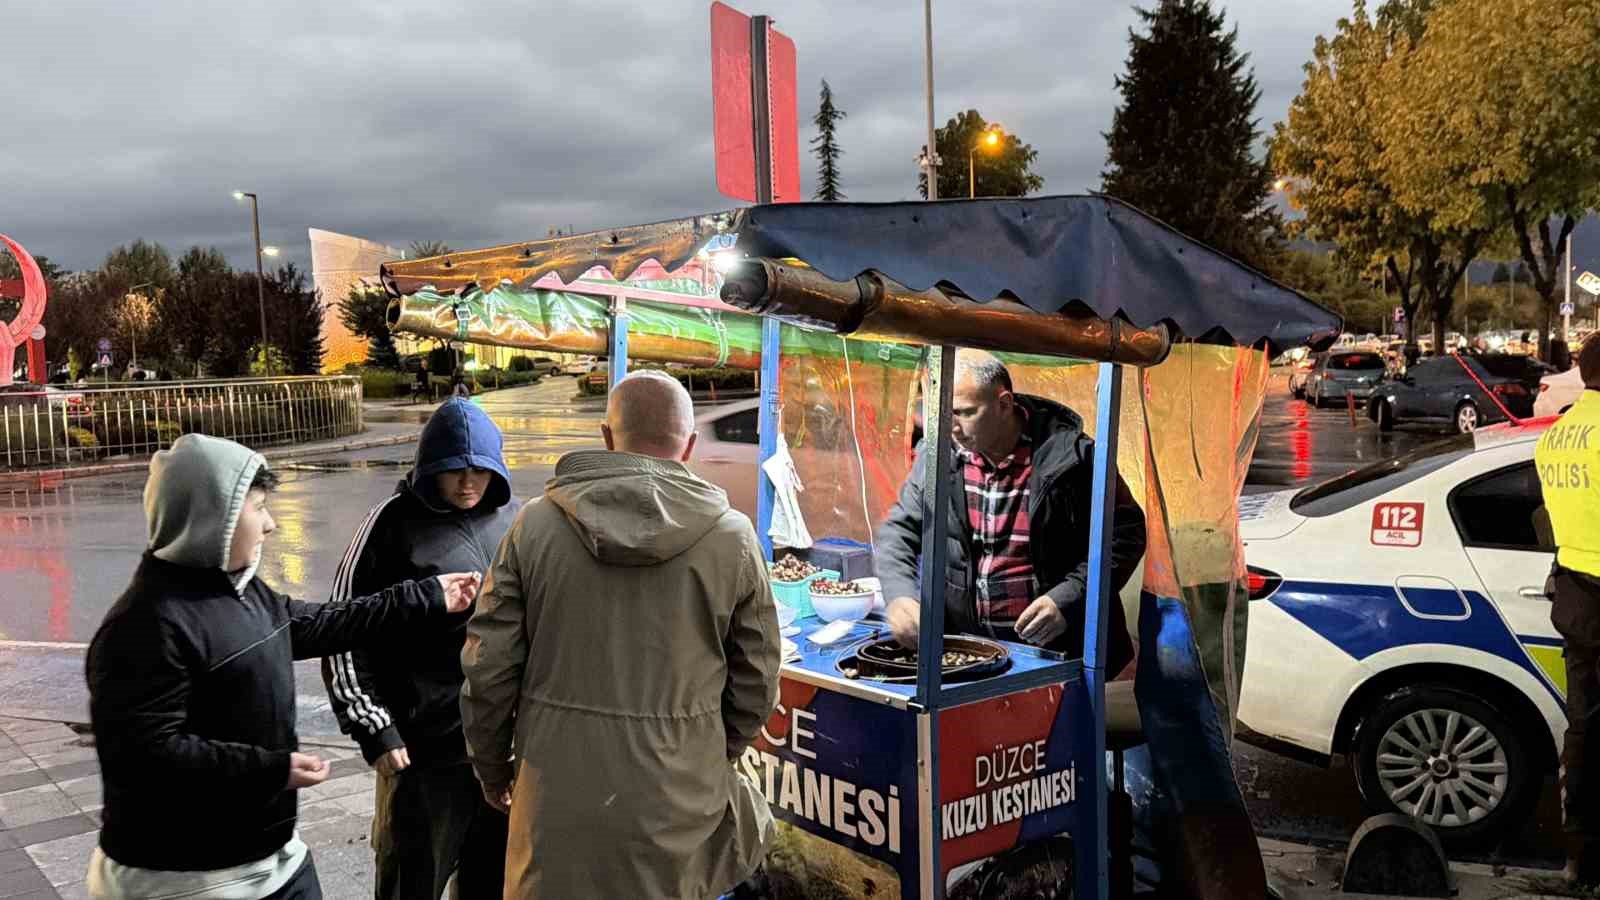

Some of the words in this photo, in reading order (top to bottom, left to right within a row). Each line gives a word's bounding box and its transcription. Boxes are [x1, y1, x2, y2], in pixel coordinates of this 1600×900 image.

[1380, 506, 1417, 528] 112
[975, 739, 1047, 788] DÜZCE
[733, 746, 901, 854] STANESİ
[941, 793, 988, 841] KUZU
[992, 760, 1076, 826] KESTANESİ
